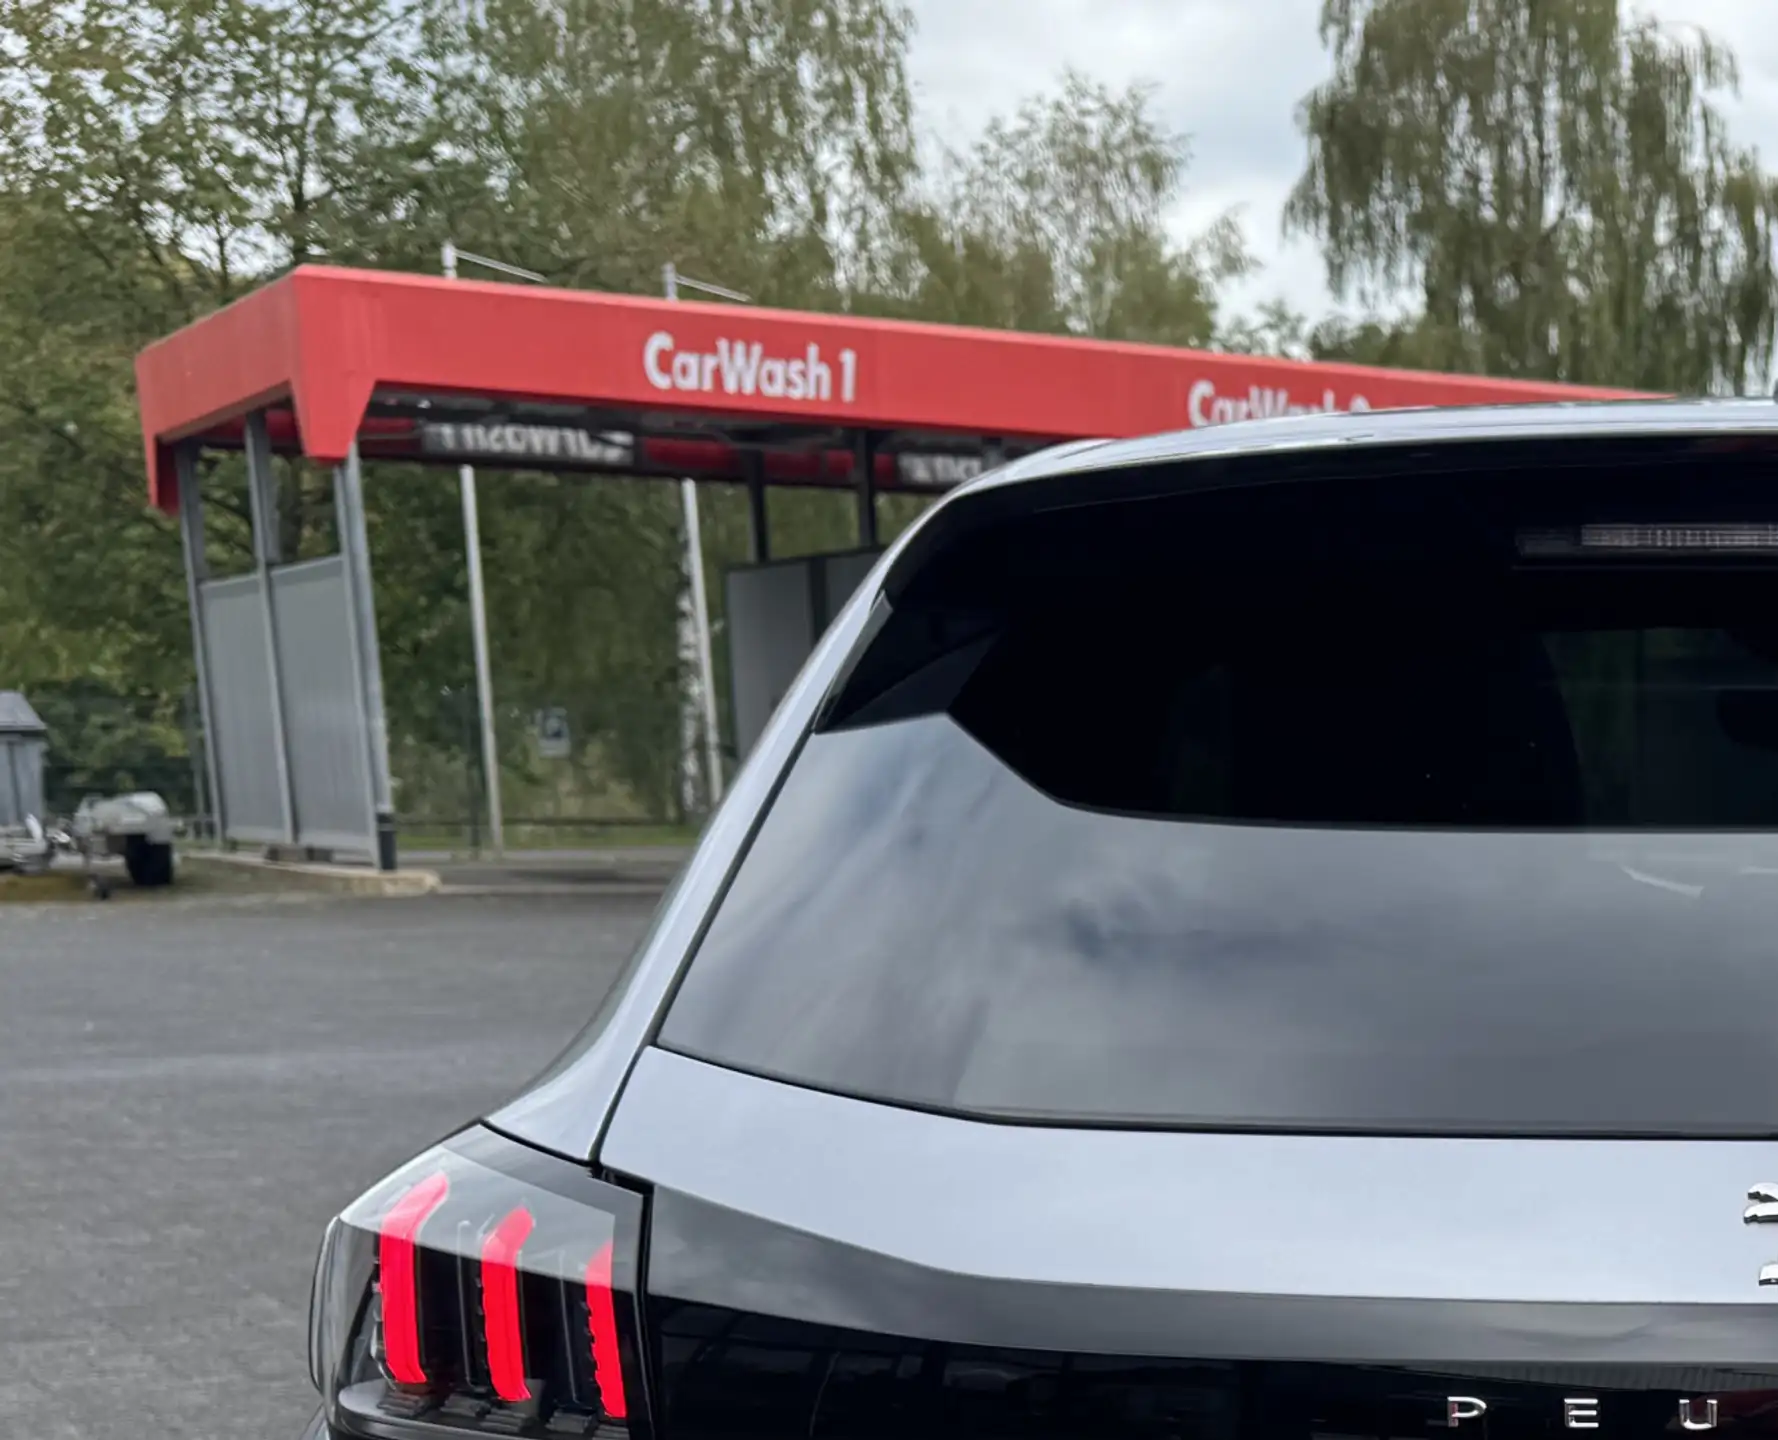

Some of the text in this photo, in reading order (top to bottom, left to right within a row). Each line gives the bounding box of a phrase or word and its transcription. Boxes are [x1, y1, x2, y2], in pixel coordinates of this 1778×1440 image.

[643, 330, 857, 403] CarWash 1
[1187, 379, 1336, 428] CarW
